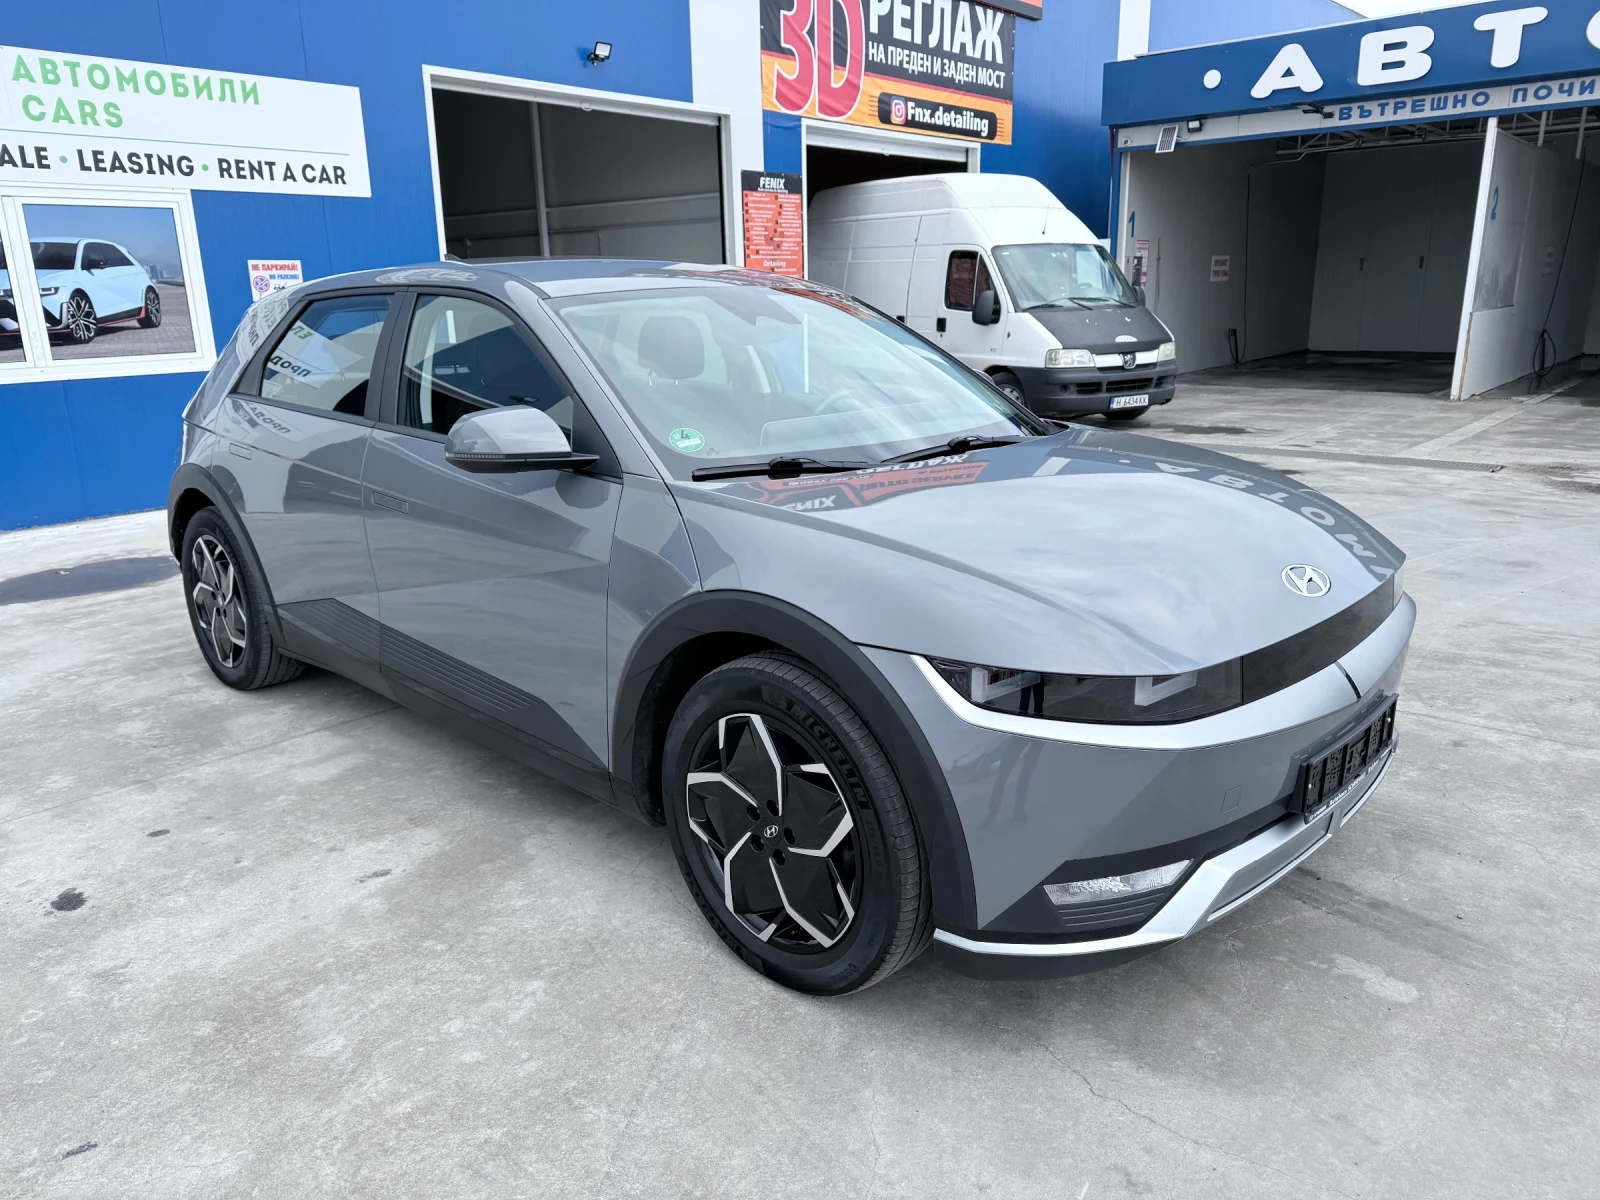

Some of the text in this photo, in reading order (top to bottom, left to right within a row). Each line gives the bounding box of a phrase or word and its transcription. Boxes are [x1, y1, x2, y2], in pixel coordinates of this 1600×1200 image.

[773, 0, 1004, 121] 3D РЕГЛАЖ
[868, 41, 1006, 89] НА ПРЕДЕН И ЗАДЕН МОСТ
[11, 54, 260, 105] АВТОМОБИЛИ
[21, 94, 124, 128] CARS
[1338, 79, 1597, 121] ВЪТРЕШНО ПОЧИ
[907, 101, 989, 137] Fnx.detailing
[76, 149, 195, 177] LEASING
[217, 157, 276, 181] RENT
[282, 161, 298, 182] A
[301, 163, 348, 185] CAR
[760, 176, 785, 190] FENIX
[1490, 186, 1499, 220] 2
[1128, 211, 1135, 237] 1
[680, 429, 691, 440] 4
[789, 706, 869, 803] MICHELIN
